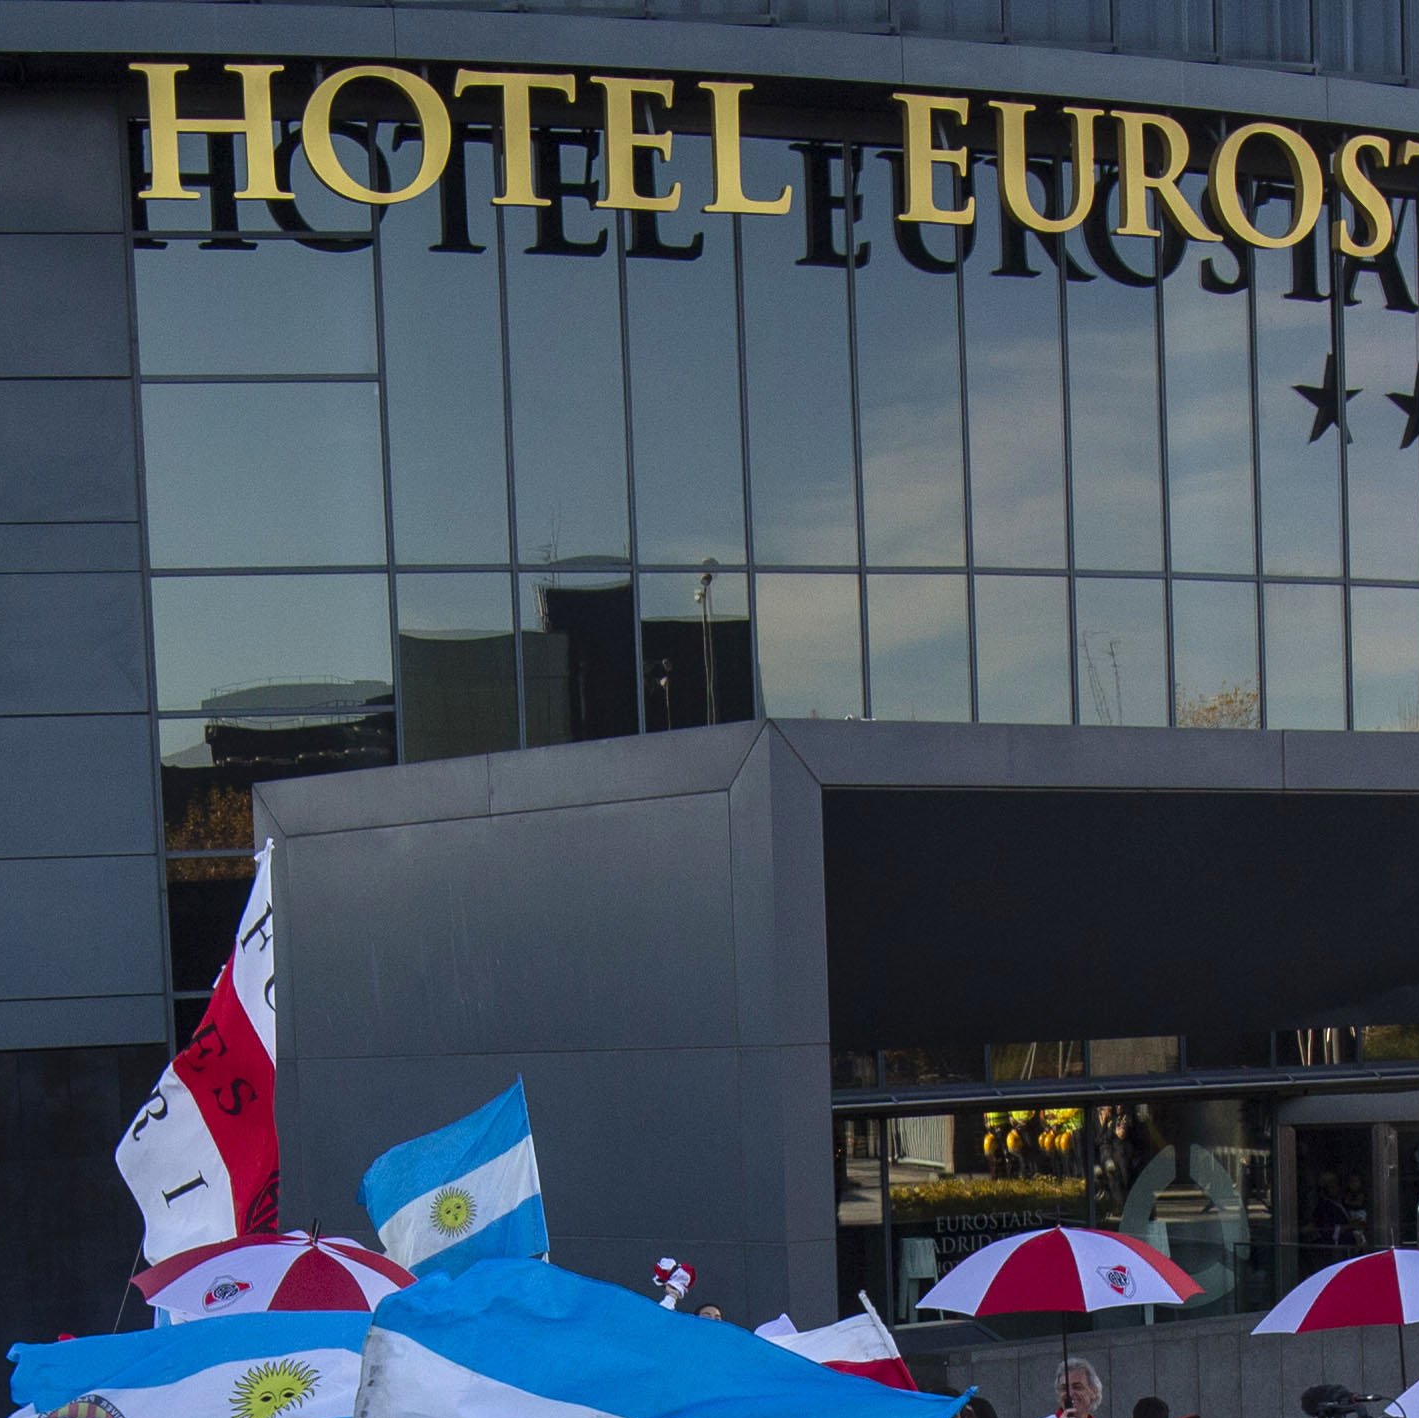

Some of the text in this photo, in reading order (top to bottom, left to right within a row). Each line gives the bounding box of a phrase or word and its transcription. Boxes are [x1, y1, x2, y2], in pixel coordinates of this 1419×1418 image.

[130, 62, 794, 214] HOTEL
[935, 1210, 1043, 1233] EUROSTARS
[933, 1234, 992, 1254] ADRID
